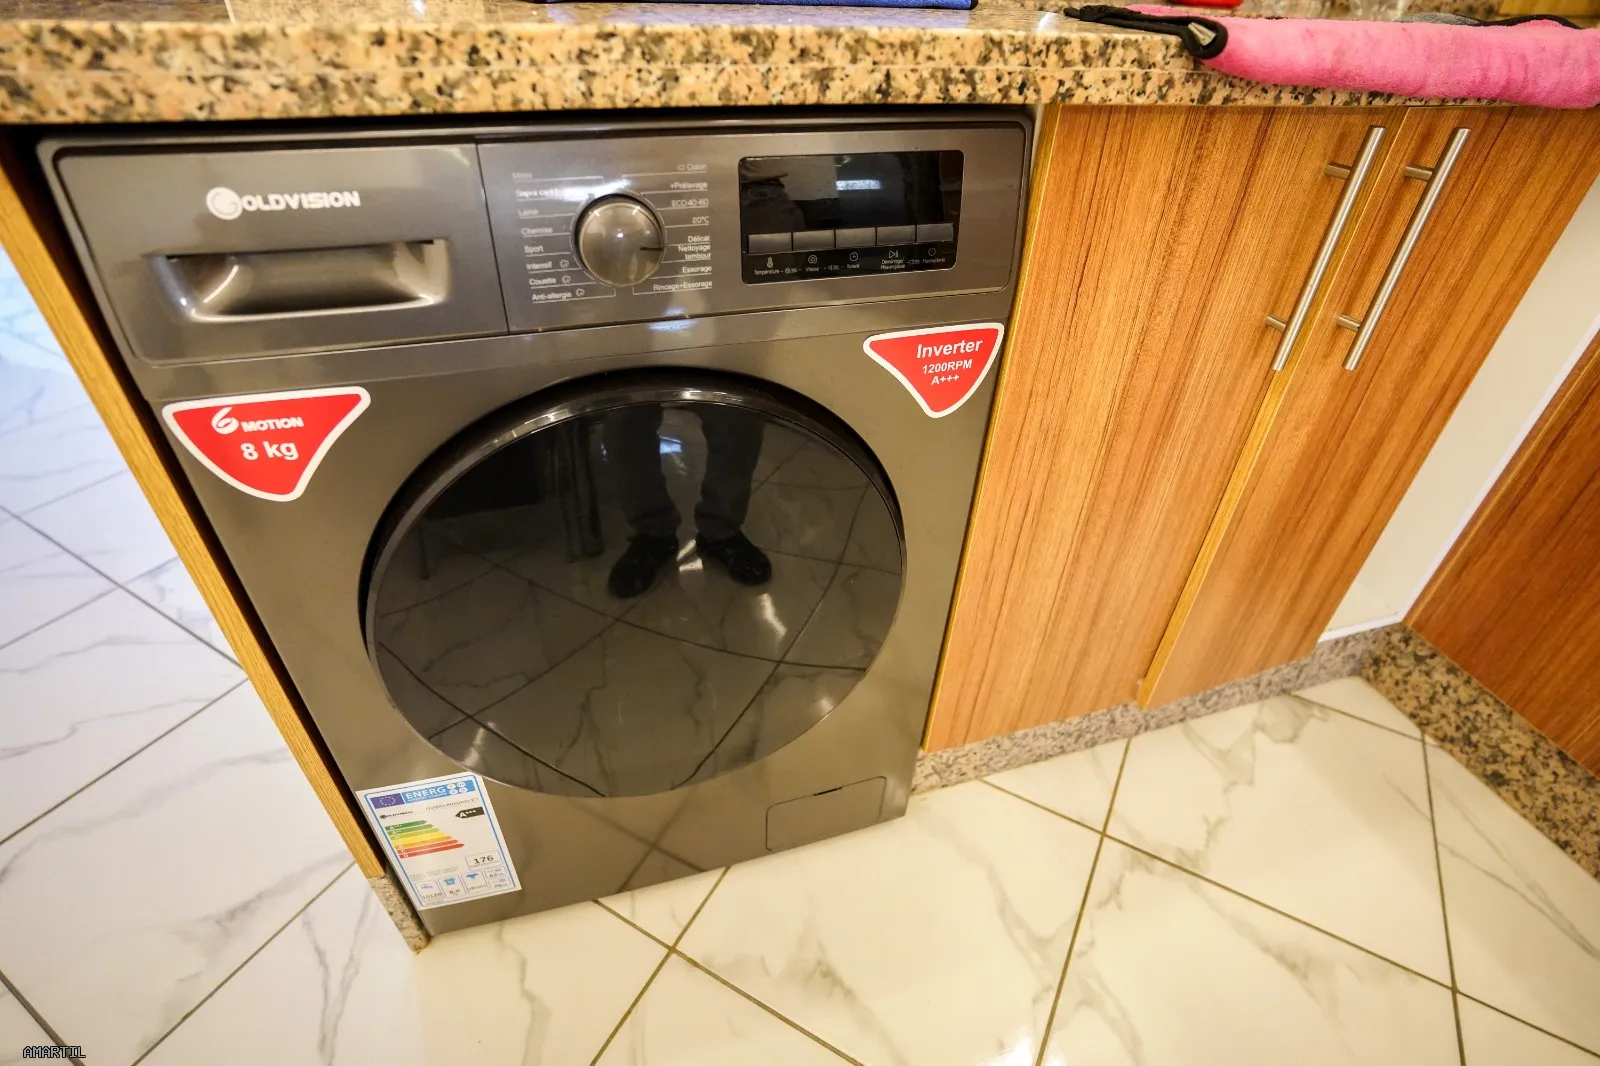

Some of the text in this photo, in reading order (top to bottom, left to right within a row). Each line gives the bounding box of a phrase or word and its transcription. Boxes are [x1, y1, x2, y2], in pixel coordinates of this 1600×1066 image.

[524, 245, 544, 254] Sport
[678, 244, 711, 252] Nettoyage
[526, 261, 553, 270] Intensif
[529, 277, 557, 286] Couette
[532, 292, 572, 301] Anti-allergie
[916, 339, 983, 359] Inverter
[922, 359, 973, 374] 1200RPM
[931, 374, 960, 385] A+++
[241, 416, 304, 432] MOTION
[240, 441, 299, 461] 8 kg
[405, 786, 447, 800] ENERG
[474, 855, 494, 864] 176
